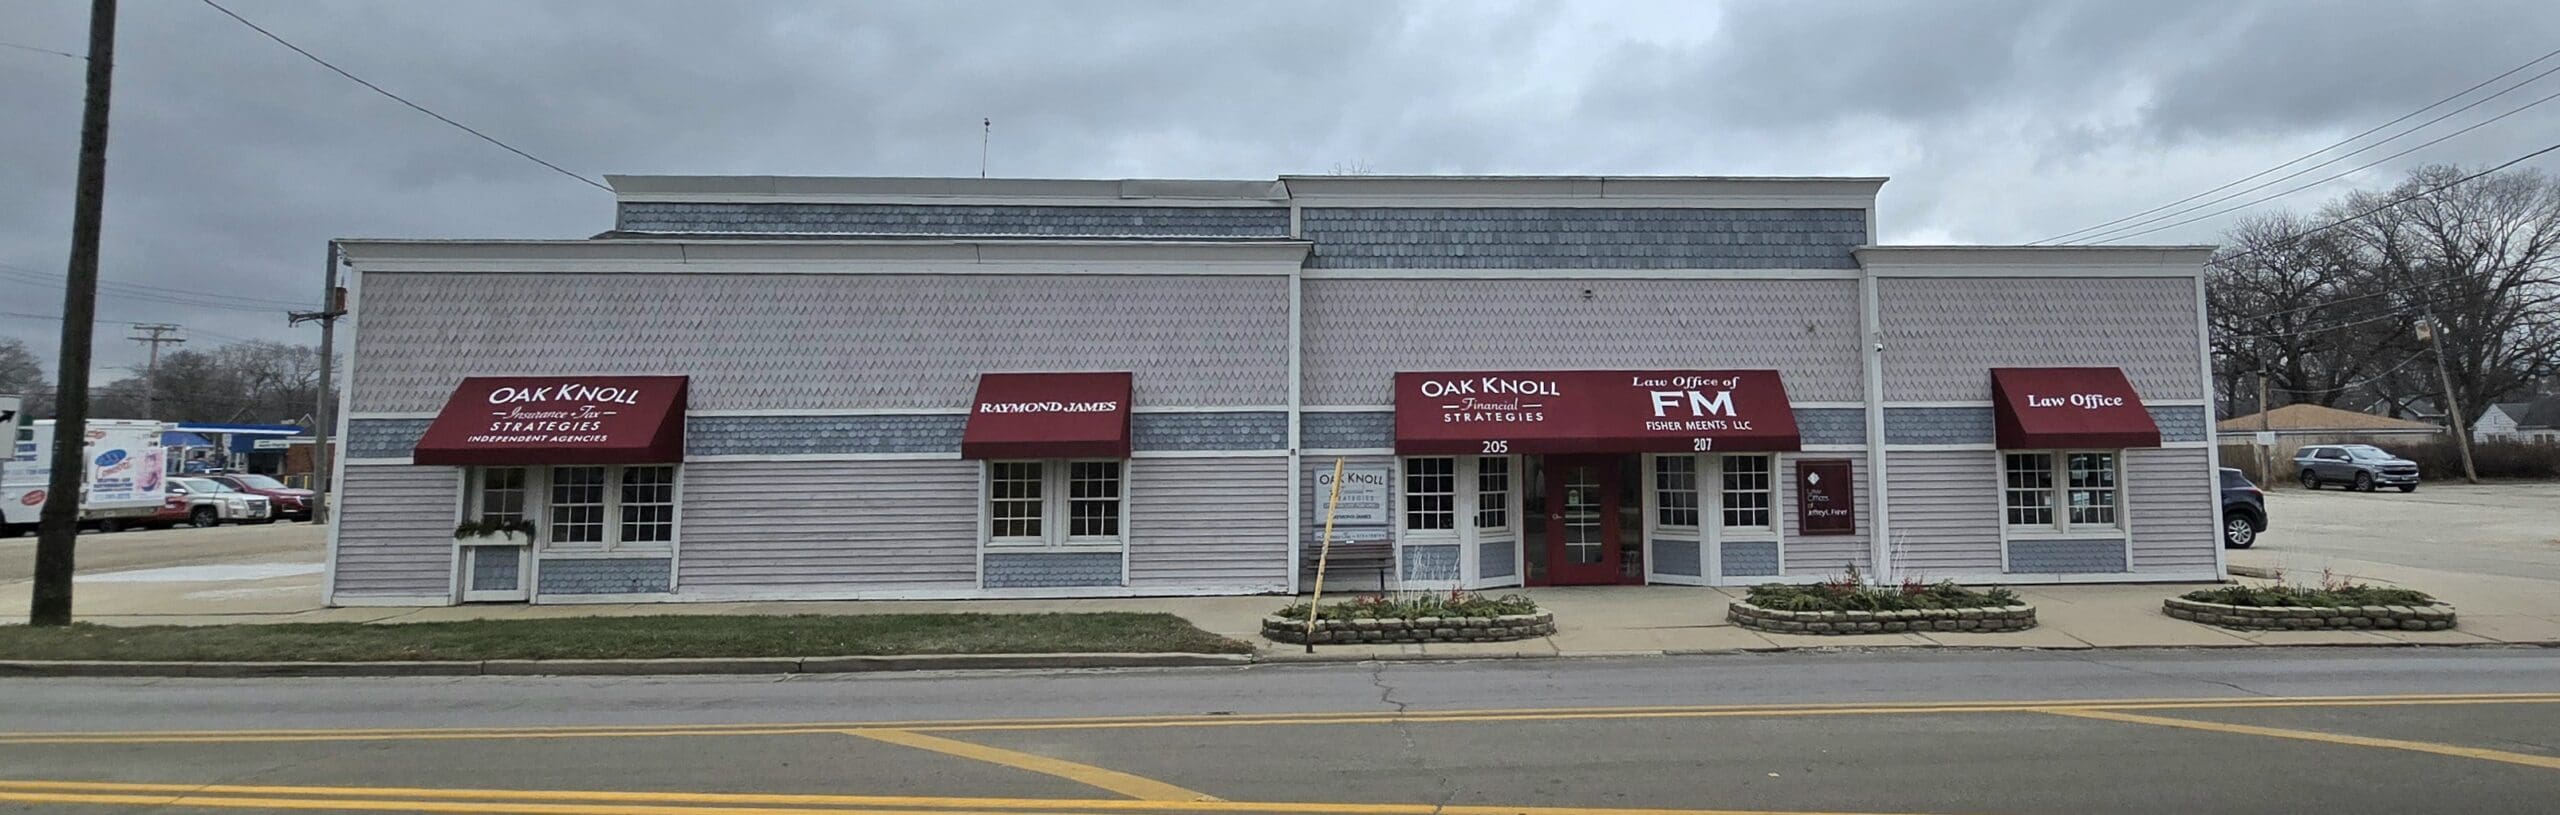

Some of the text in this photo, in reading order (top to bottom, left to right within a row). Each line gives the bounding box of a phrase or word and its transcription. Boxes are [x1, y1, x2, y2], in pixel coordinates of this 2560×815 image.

[1421, 377, 1560, 397] OAK KNOLL
[1632, 376, 1740, 389] Law Office of
[488, 383, 639, 404] OAK KNOLL
[980, 401, 1117, 413] RAYMOND JAMES
[1460, 397, 1519, 411] Financial
[1650, 390, 1737, 417] FM
[2028, 394, 2123, 409] Law Office
[503, 405, 601, 419] Insurance Tax
[1444, 412, 1544, 422] STRATEGIES
[490, 421, 601, 431] STRATEGIES
[1646, 420, 1753, 431] FISHER MEENTS LLC
[467, 434, 608, 443] INDEPENDENT AGENCIES
[1694, 438, 1712, 451] 207
[1482, 440, 1508, 453] 205
[1348, 472, 1383, 485] KNOLL
